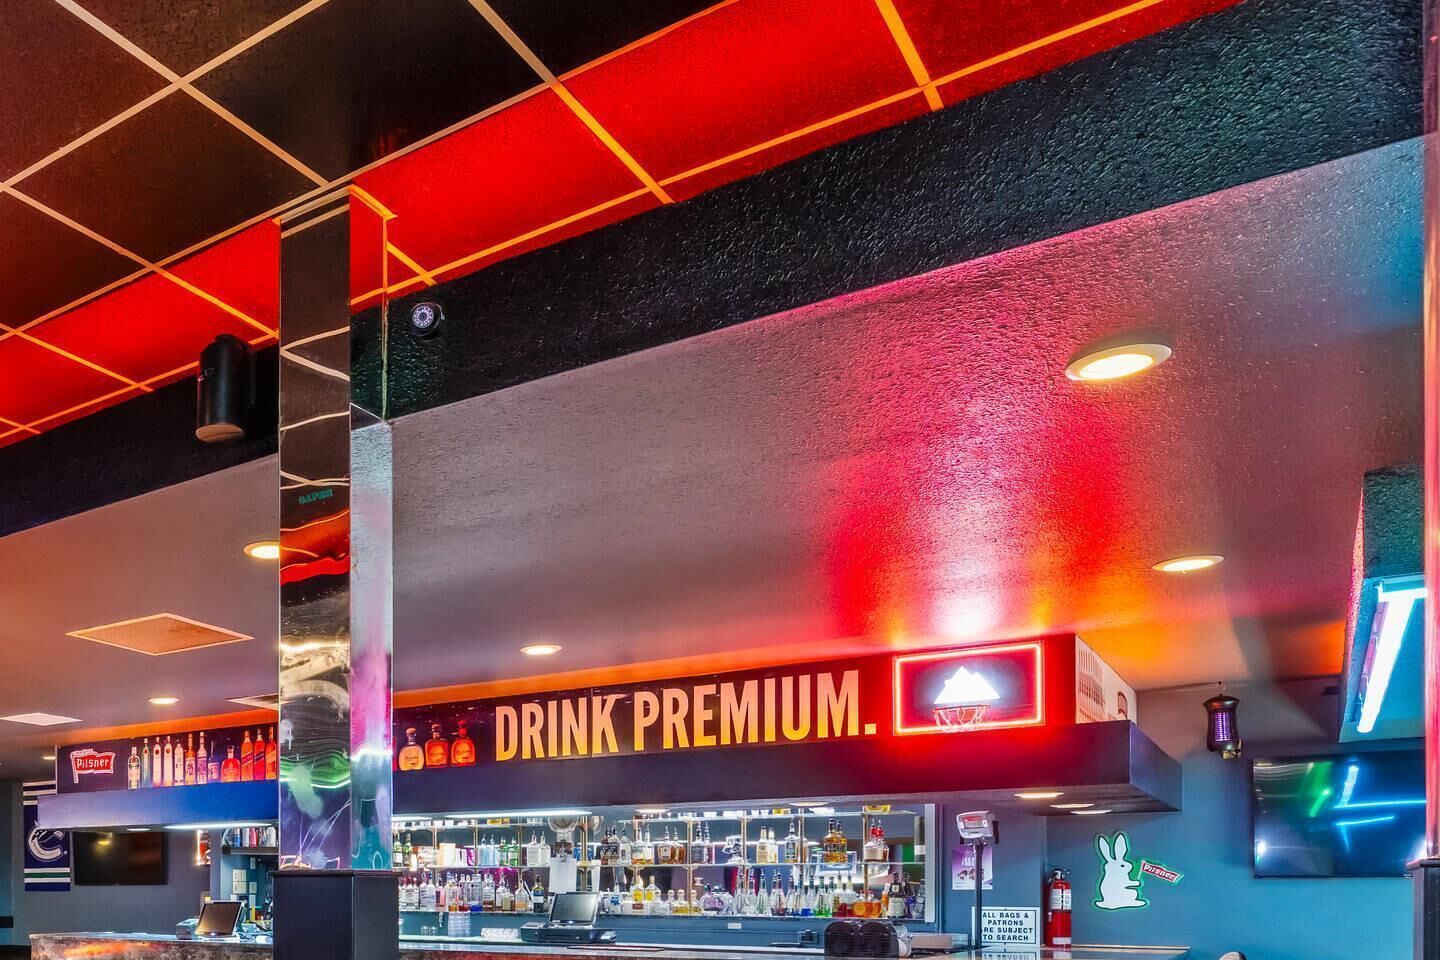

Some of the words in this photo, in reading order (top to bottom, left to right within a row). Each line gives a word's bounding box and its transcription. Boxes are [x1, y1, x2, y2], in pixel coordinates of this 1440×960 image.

[495, 694, 619, 762] DRINK
[634, 670, 877, 751] PREMIUM.
[76, 758, 110, 768] Pilsner
